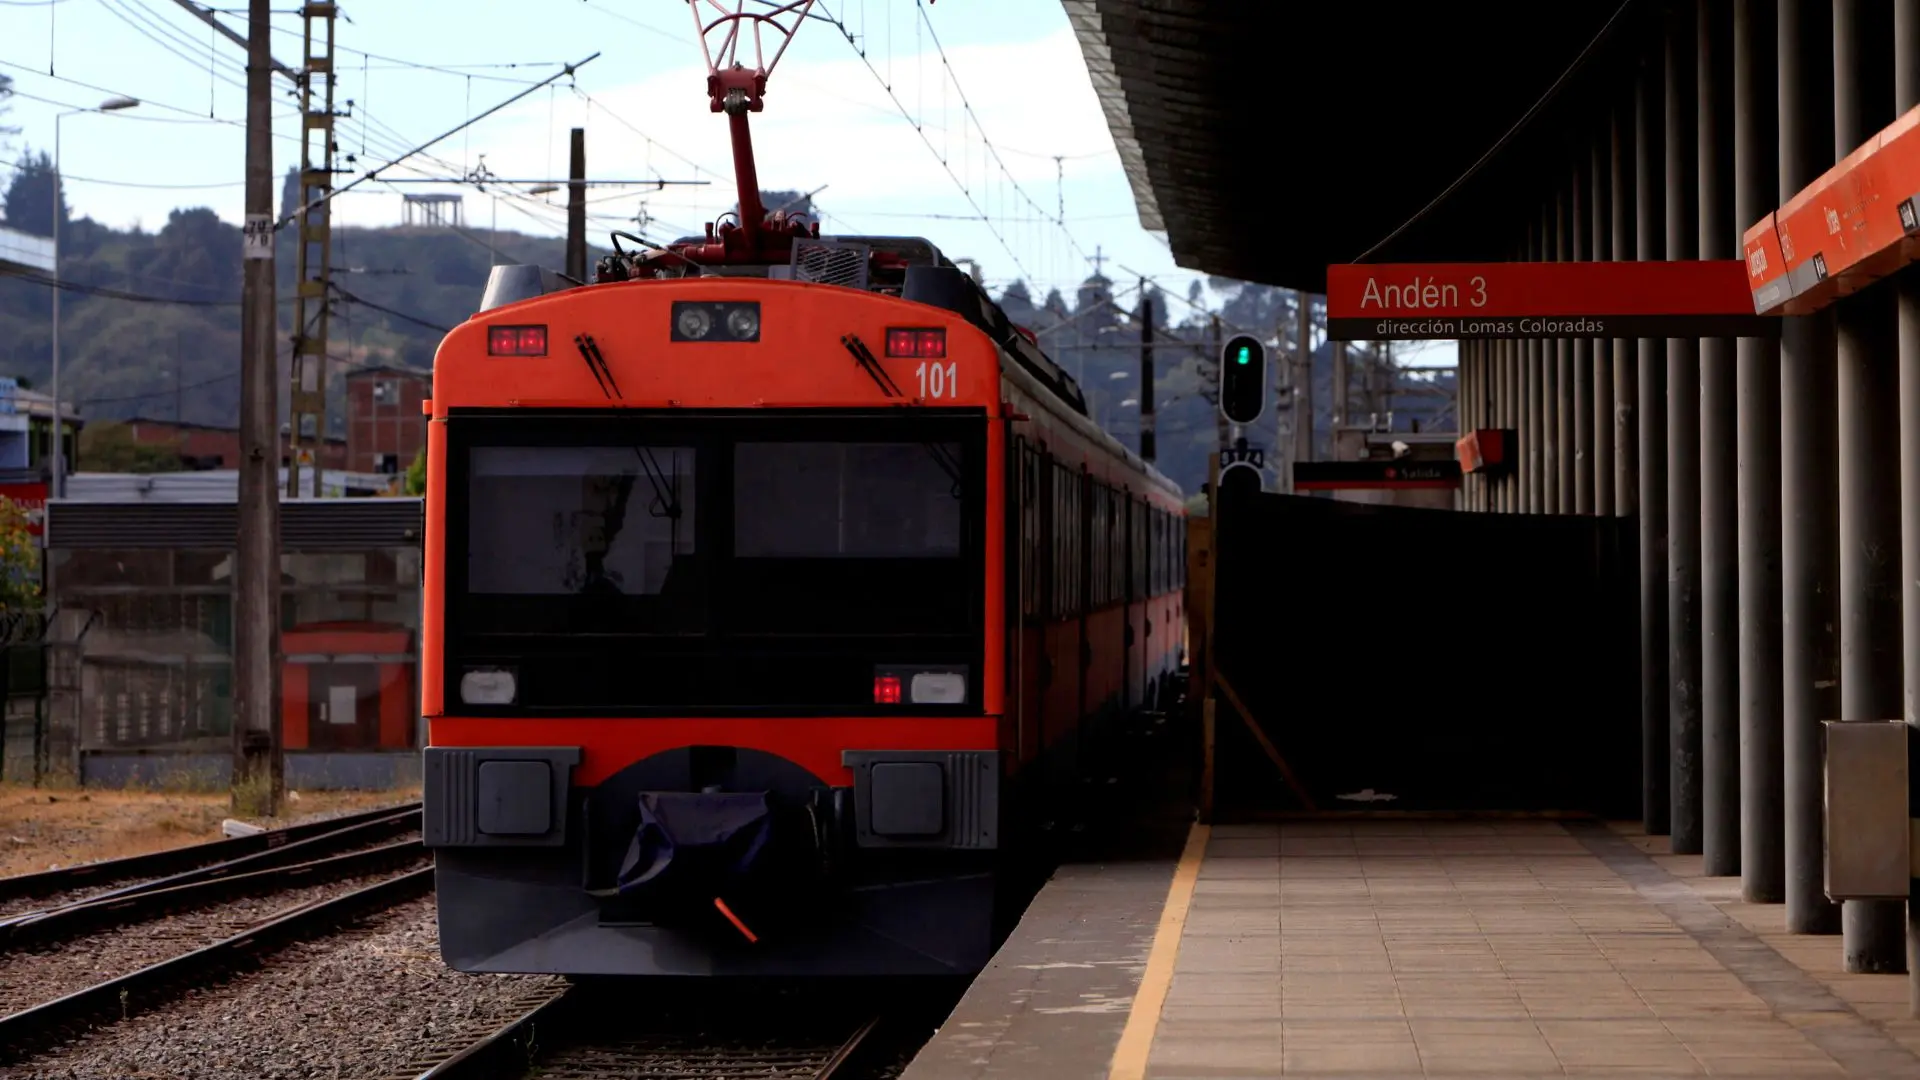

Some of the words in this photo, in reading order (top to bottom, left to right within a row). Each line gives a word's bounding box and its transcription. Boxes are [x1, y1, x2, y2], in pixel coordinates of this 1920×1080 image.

[1360, 276, 1458, 308] Andén
[1470, 276, 1487, 307] 3
[1376, 319, 1454, 334] dirección
[1460, 319, 1514, 334] Lomas
[1519, 317, 1604, 333] Coloradas
[916, 361, 956, 399] 101
